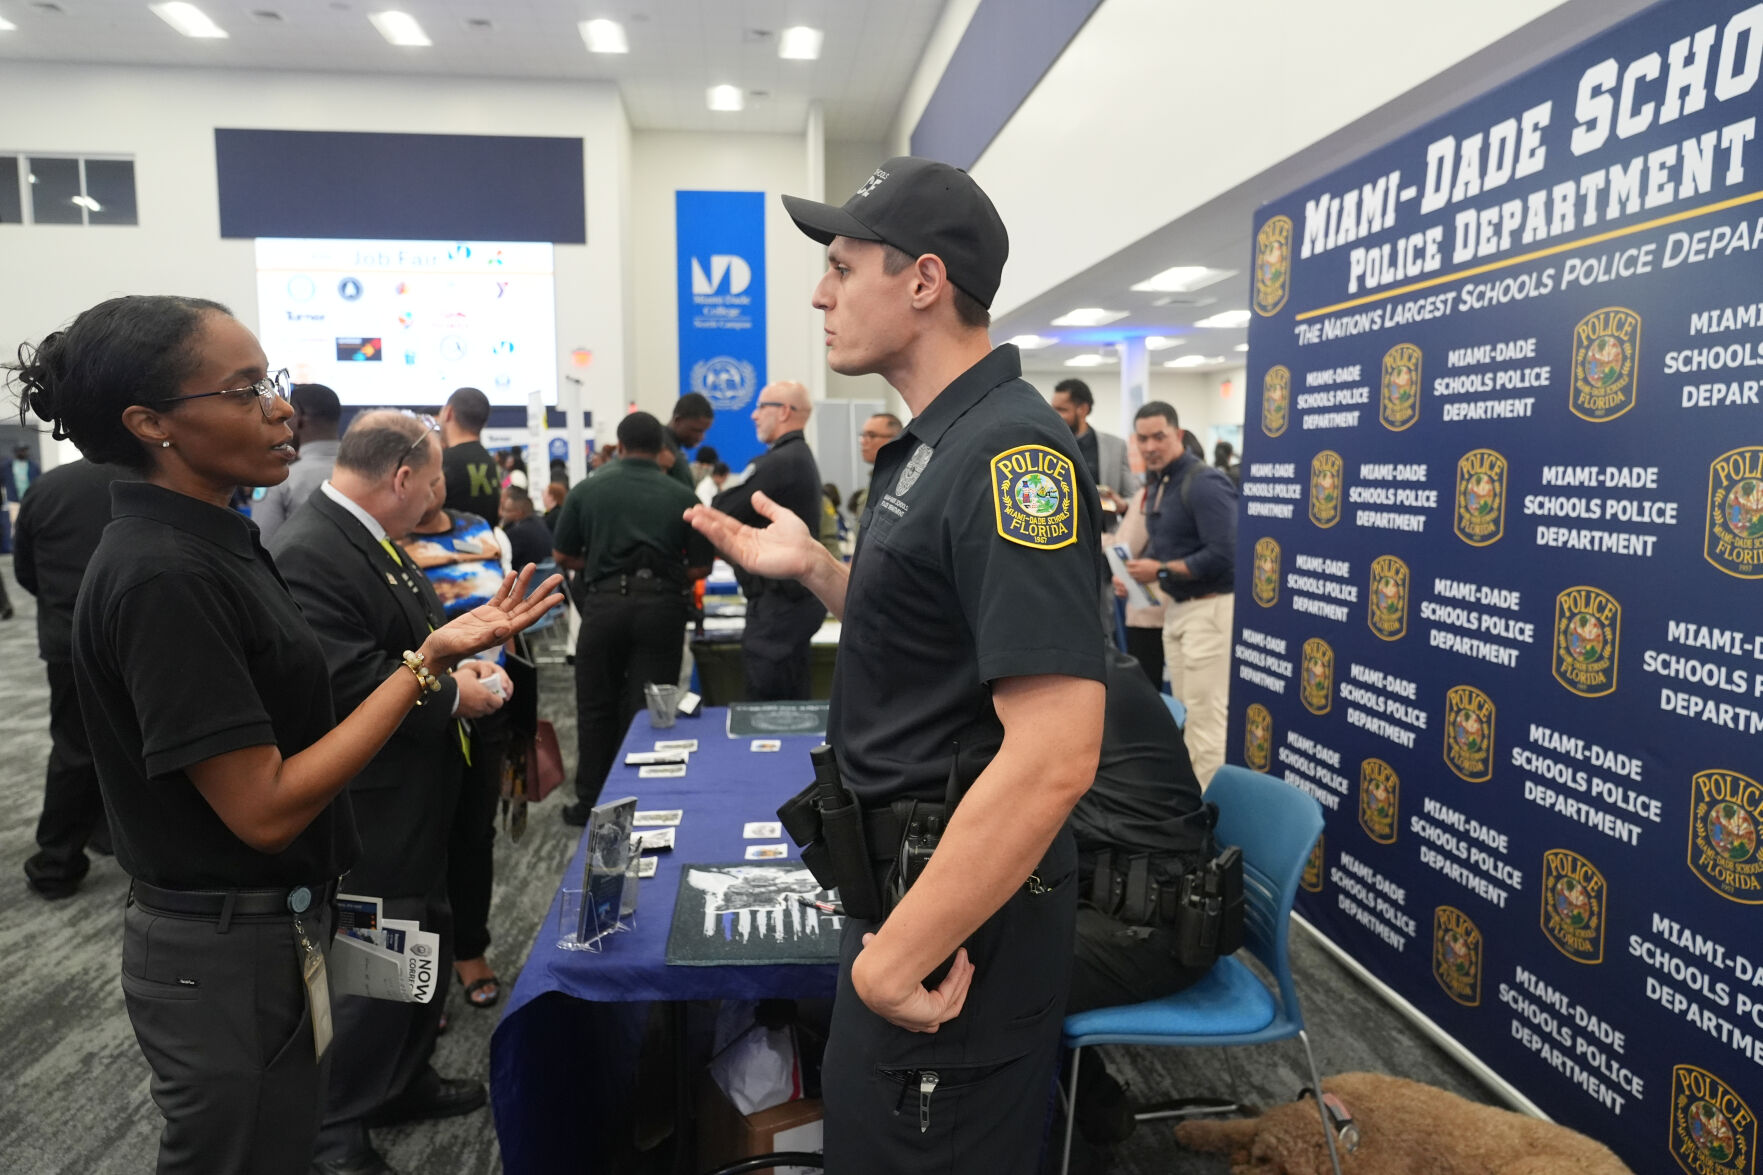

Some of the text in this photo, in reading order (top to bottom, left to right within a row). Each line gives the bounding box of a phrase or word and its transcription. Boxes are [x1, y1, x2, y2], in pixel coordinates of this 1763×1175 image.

[1300, 100, 1553, 260] MIAMI-DADE
[1348, 116, 1757, 294] POLICE DEPARTMENT
[354, 250, 438, 266] Job Fair
[1322, 308, 1383, 341] NATION'S
[1384, 291, 1457, 328] LARGEST
[1458, 267, 1554, 312] SCHOOLS
[1560, 242, 1657, 290] POLICE
[1578, 311, 1635, 346] POLICE
[1448, 338, 1536, 367] MIAMI-DADE
[1306, 365, 1360, 386] MIAMI-DADE
[1434, 367, 1550, 395] SCHOOLS POLICE
[1297, 387, 1369, 409] SCHOOLS POLICE
[1443, 398, 1535, 421] DEPARTMENT
[1578, 390, 1626, 411] FLORIDA
[1682, 380, 1763, 407] DEPAR
[1303, 411, 1359, 429] DEPARTMENT
[997, 451, 1069, 481] POLICE
[1251, 464, 1294, 477] MIAMI-DADE
[1360, 464, 1427, 481] MIAMI-DADE
[1461, 453, 1503, 480] POLICE
[1543, 466, 1658, 488] MIAMI-DADE
[1243, 483, 1301, 498] SCHOOLS POLICE
[1349, 487, 1437, 507] SCHOOLS POLICE
[1004, 505, 1070, 525] MIAMI-DADE SCHOOLS
[1248, 502, 1293, 518] DEPARTMENT
[1357, 510, 1425, 531] DEPARTMENT
[1524, 495, 1601, 518] SCHOOLS
[1606, 500, 1677, 524] POLICE
[1010, 518, 1069, 538] FLORIDA
[1537, 526, 1657, 556] DEPARTMENT
[1296, 555, 1349, 577] MIAMI-DADE
[1373, 559, 1406, 585] POLICE
[1287, 574, 1324, 594] SCHOOLS
[1325, 581, 1357, 602] POLICE
[1435, 579, 1520, 610] MIAMI-DADE
[1293, 596, 1348, 621] DEPARTMENT
[1421, 602, 1534, 642] SCHOOLS POLICE
[1561, 590, 1616, 625] POLICE
[1243, 629, 1286, 654] MIAMI-DADE
[1430, 629, 1519, 667] DEPARTMENT
[1236, 645, 1292, 677] SCHOOLS POLICE
[1559, 660, 1607, 684] FLORIDA
[1643, 651, 1747, 693] SCHOOLS
[1240, 665, 1285, 693] DEPARTMENT
[1351, 664, 1416, 699] MIAMI-DADE
[1340, 683, 1388, 714] SCHOOLS
[1387, 700, 1426, 728] POLICE
[1449, 690, 1492, 723] POLICE
[1347, 708, 1415, 748] DEPARTMENT
[1288, 731, 1340, 767] MIAMI-DADE
[1530, 724, 1642, 781] MIAMI-DADE
[1279, 747, 1348, 794] SCHOOLS POLICE
[1512, 748, 1661, 822] SCHOOLS POLICE
[1424, 798, 1507, 853] MIAMI-DADE
[1525, 781, 1641, 845] DEPARTMENT
[1411, 816, 1522, 889] SCHOOLS POLICE
[1341, 852, 1405, 905] MIAMI-DADE
[1421, 846, 1507, 907] DEPARTMENT
[1547, 853, 1602, 897] POLICE
[1699, 854, 1762, 890] FLORIDA
[1331, 868, 1415, 936] SCHOOLS POLICE
[1339, 894, 1405, 951] DEPARTMENT
[1438, 911, 1479, 949] POLICE
[1550, 921, 1595, 952] FLORIDA
[414, 959, 432, 1001] NOW
[1629, 935, 1729, 1006] SCHOOLS
[1516, 966, 1624, 1053] MIAMI-DADE
[1499, 984, 1643, 1099] SCHOOLS POLICE
[1512, 1020, 1625, 1113] DEPARTMENT
[1678, 1069, 1751, 1132] POLICE
